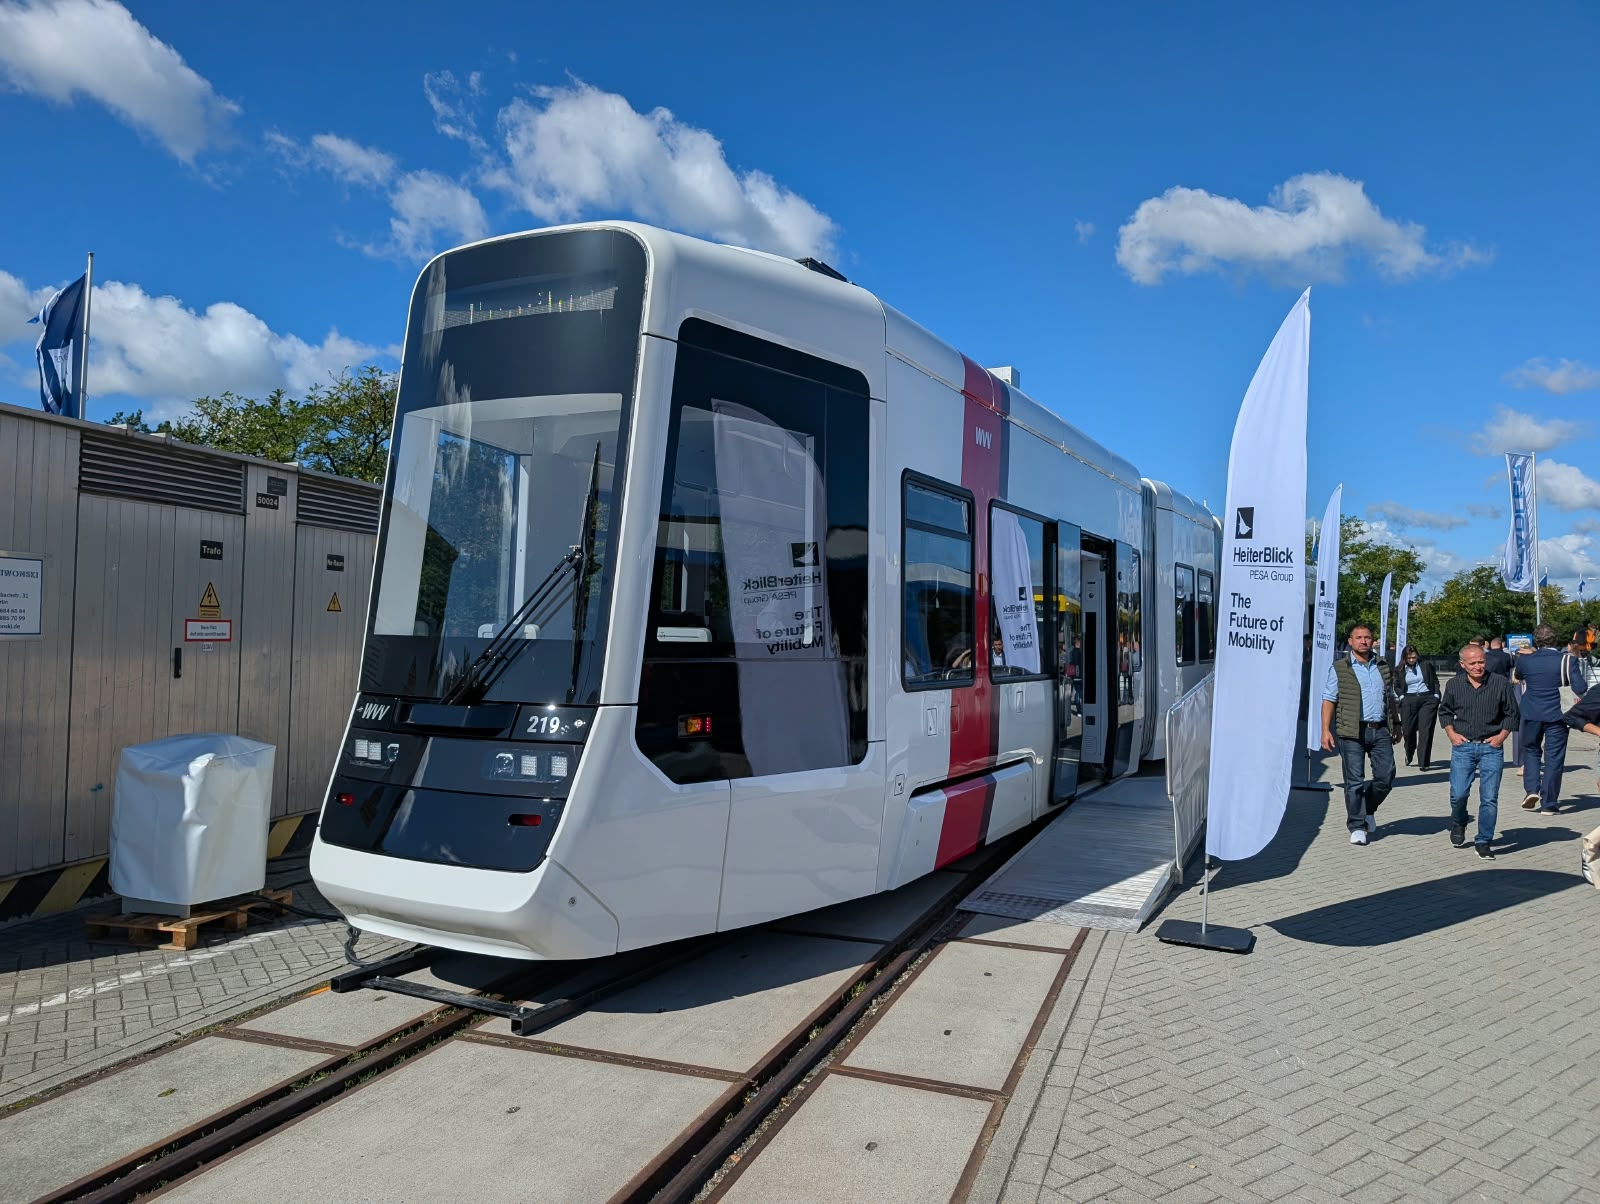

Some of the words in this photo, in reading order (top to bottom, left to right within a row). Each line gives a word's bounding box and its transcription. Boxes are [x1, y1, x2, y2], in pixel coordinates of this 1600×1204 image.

[257, 496, 279, 507] 50024
[201, 545, 222, 555] Trafo
[1233, 547, 1294, 563] HeiterBlick
[1249, 570, 1269, 580] PESA
[1270, 571, 1294, 583] Group
[1230, 593, 1251, 609] The
[1229, 612, 1268, 630] Future
[1270, 616, 1284, 632] of
[1228, 631, 1275, 655] Mobility
[526, 715, 561, 734] 219
